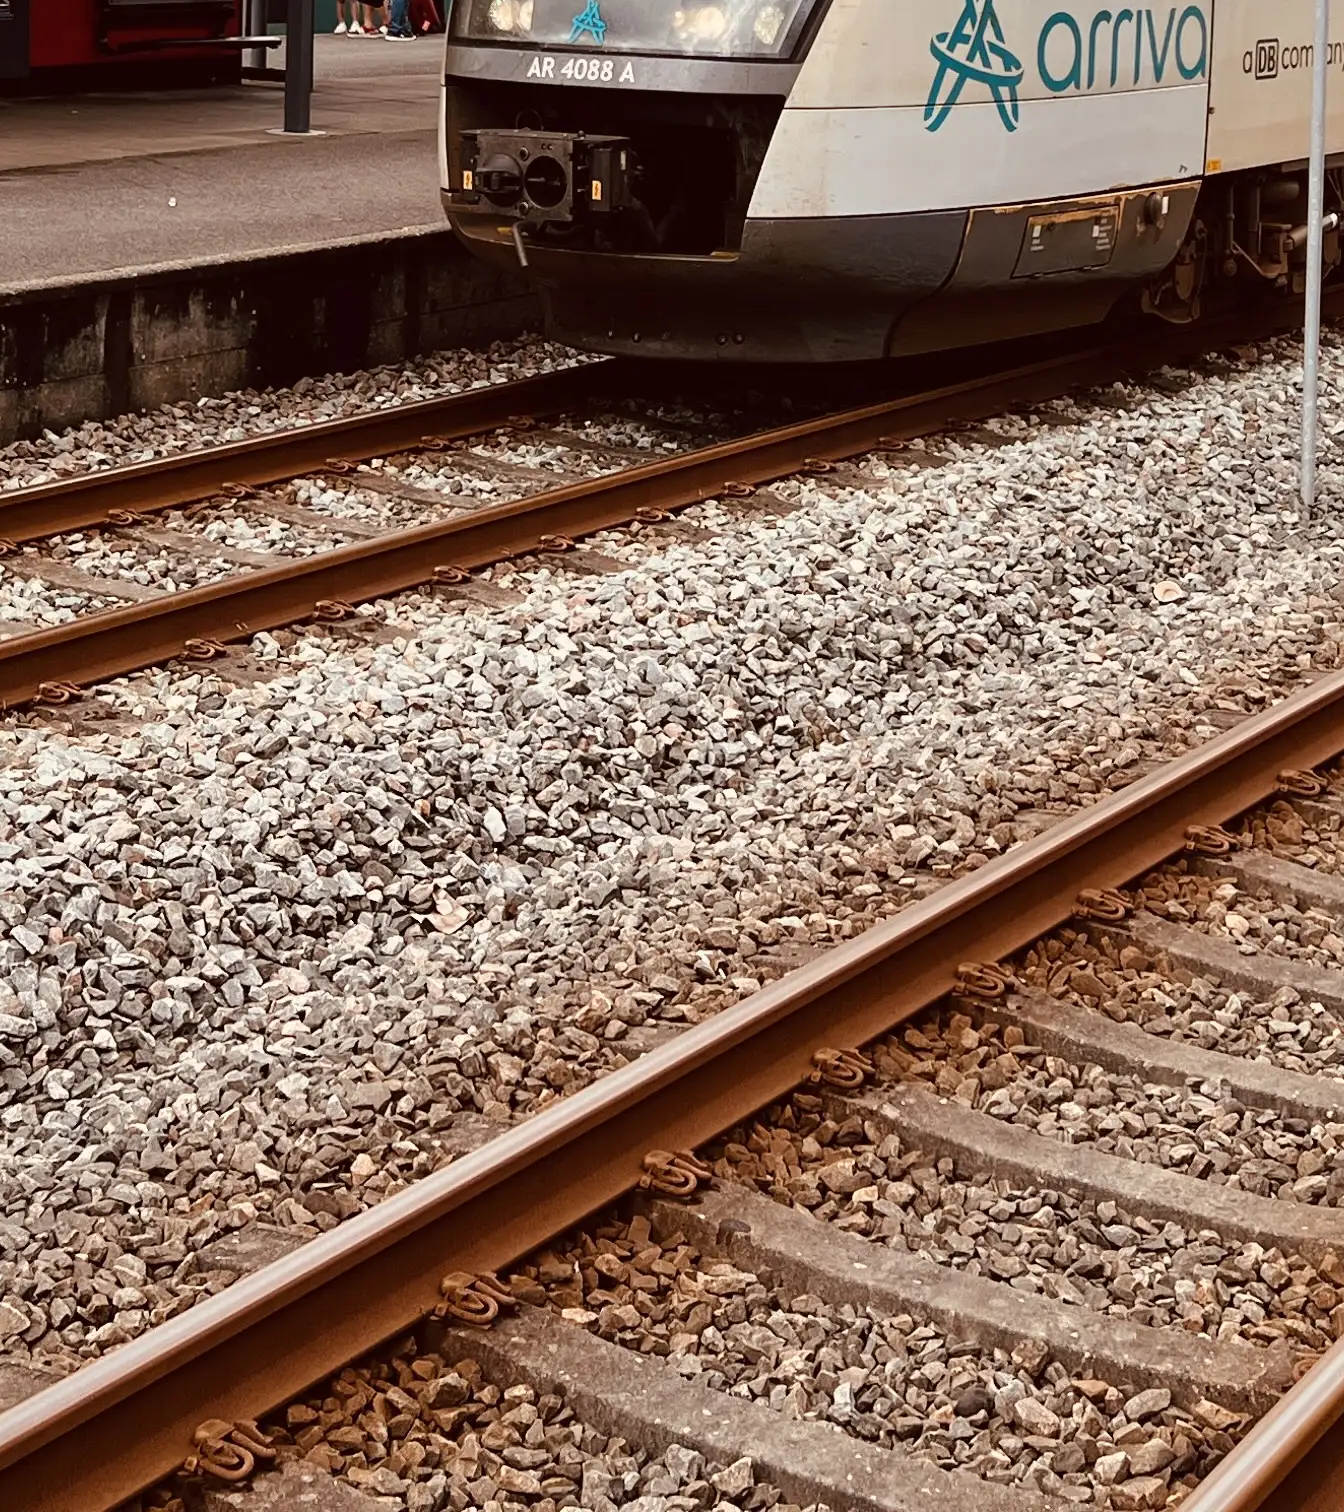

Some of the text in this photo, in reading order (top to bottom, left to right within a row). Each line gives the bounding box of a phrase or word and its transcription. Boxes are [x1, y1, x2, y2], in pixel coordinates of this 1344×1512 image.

[526, 56, 635, 83] AR 4088 A
[1242, 50, 1254, 74] a
[1257, 44, 1277, 75] DB
